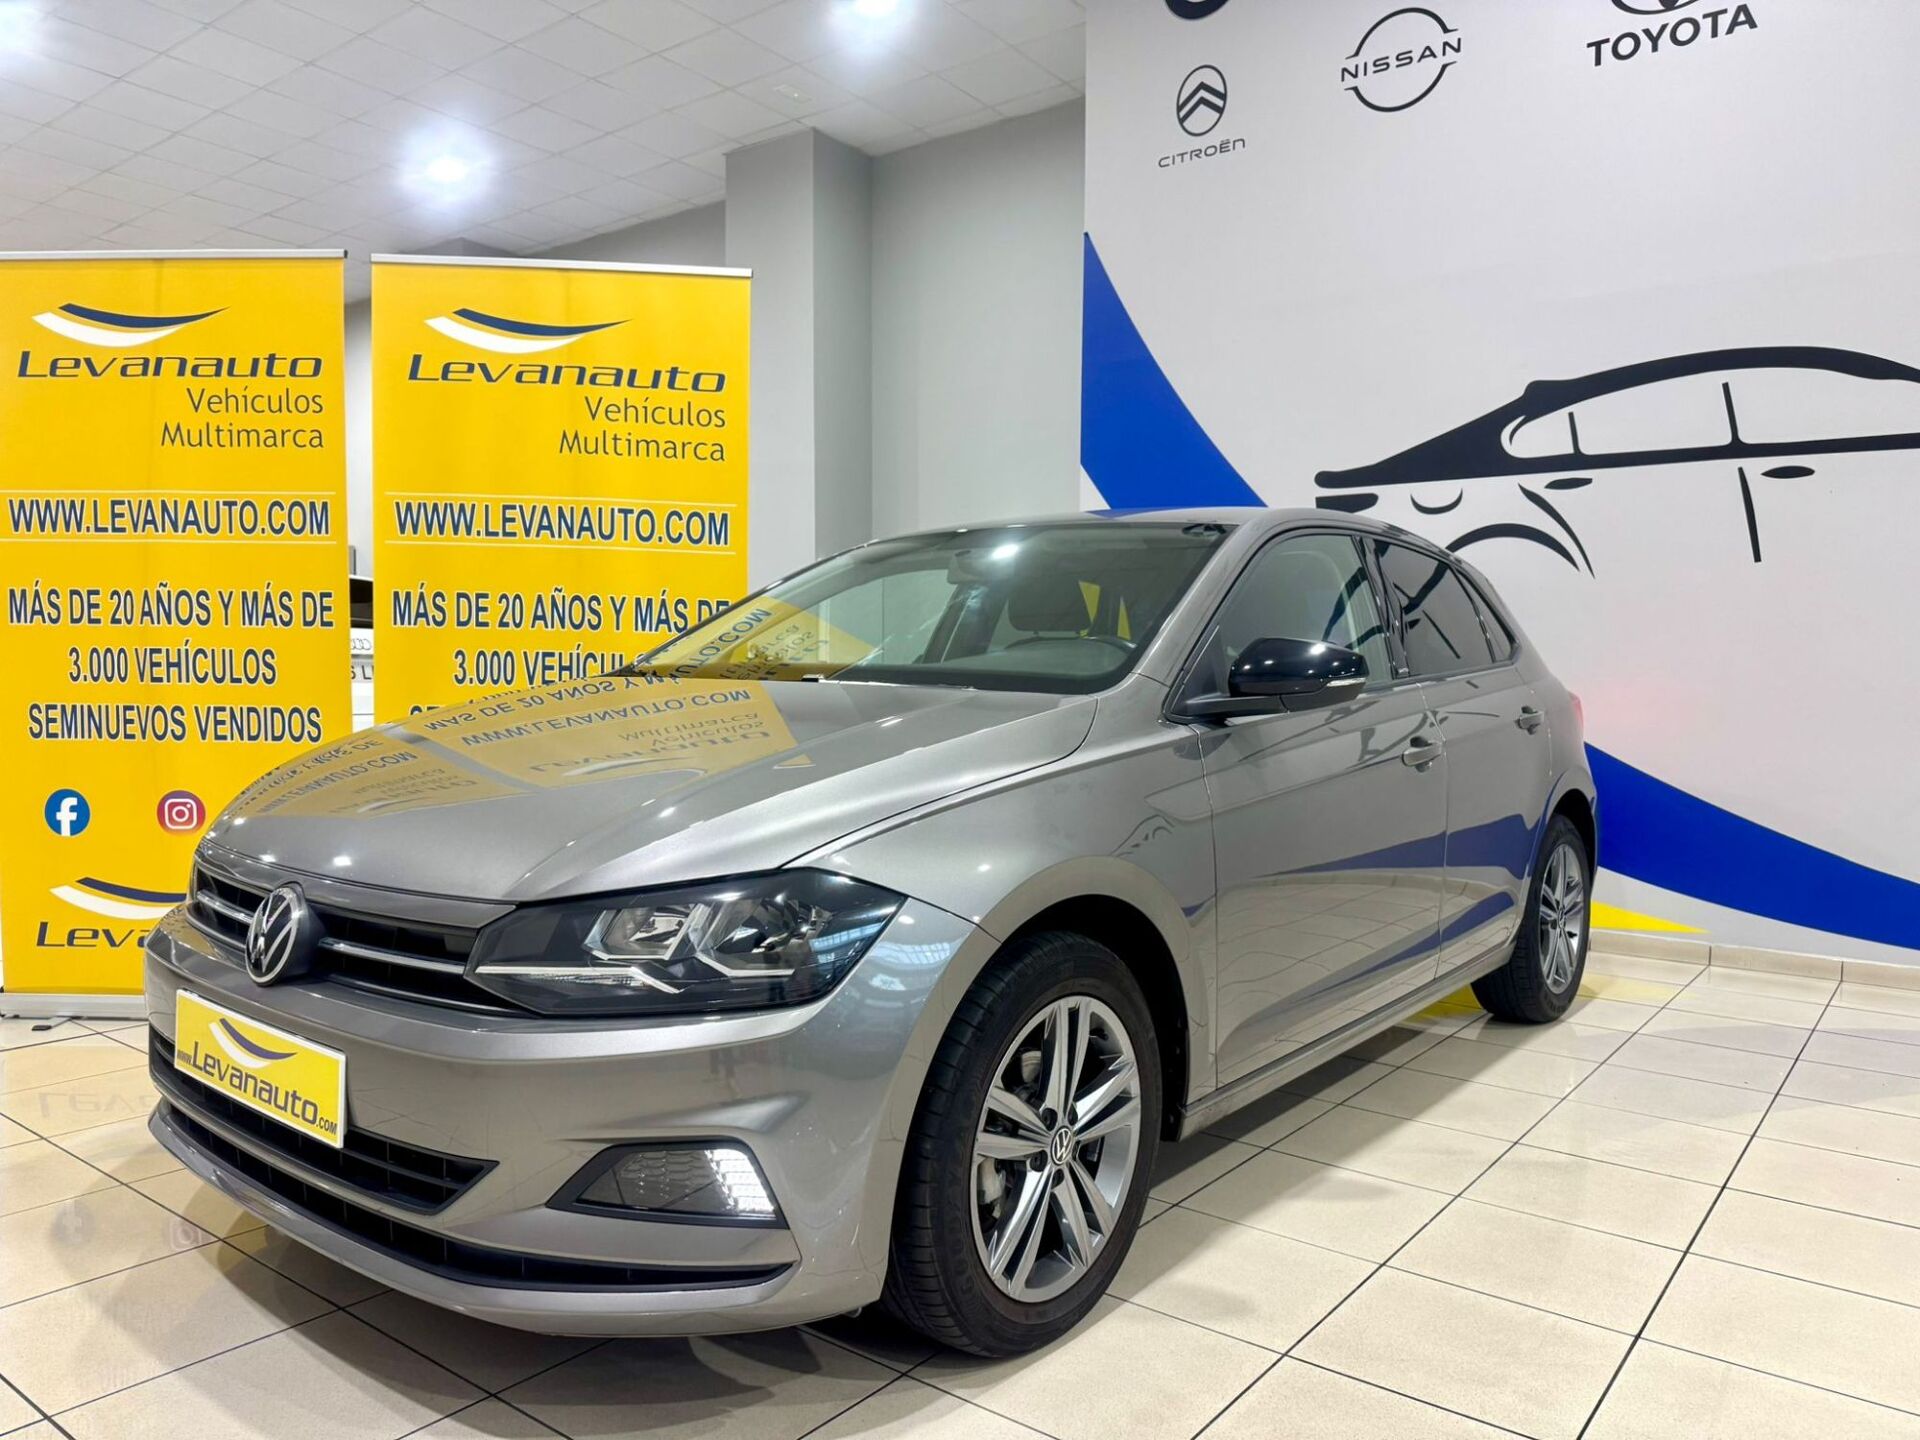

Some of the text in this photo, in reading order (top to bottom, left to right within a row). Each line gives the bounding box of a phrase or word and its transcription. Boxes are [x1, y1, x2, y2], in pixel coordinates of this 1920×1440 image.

[1586, 3, 1758, 67] TOYOTA
[1341, 37, 1462, 82] NISSAN
[17, 350, 323, 378] Levanauto
[407, 353, 727, 392] Levanauto
[186, 385, 324, 414] Vehículos
[583, 396, 727, 429] Vehículos
[160, 421, 324, 448] Multimarca
[558, 429, 726, 461] Multimarca
[8, 498, 330, 536] WWW.LEVANAUTO.COM
[395, 500, 730, 545] WWW.LEVANAUTO.COM
[8, 580, 334, 628] MÁS DE 20 AÑOS Y MÁS DE
[393, 582, 447, 628] MÁS
[455, 591, 490, 629] DE
[498, 592, 525, 629] 20
[532, 586, 602, 632] AÑOS
[609, 595, 627, 632] Y
[633, 589, 690, 635] MÁS
[68, 639, 277, 685] 3.000 VEHÍCULOS
[452, 649, 517, 687] 3.000
[28, 702, 322, 744] SEMINUEVOS VENDIDOS
